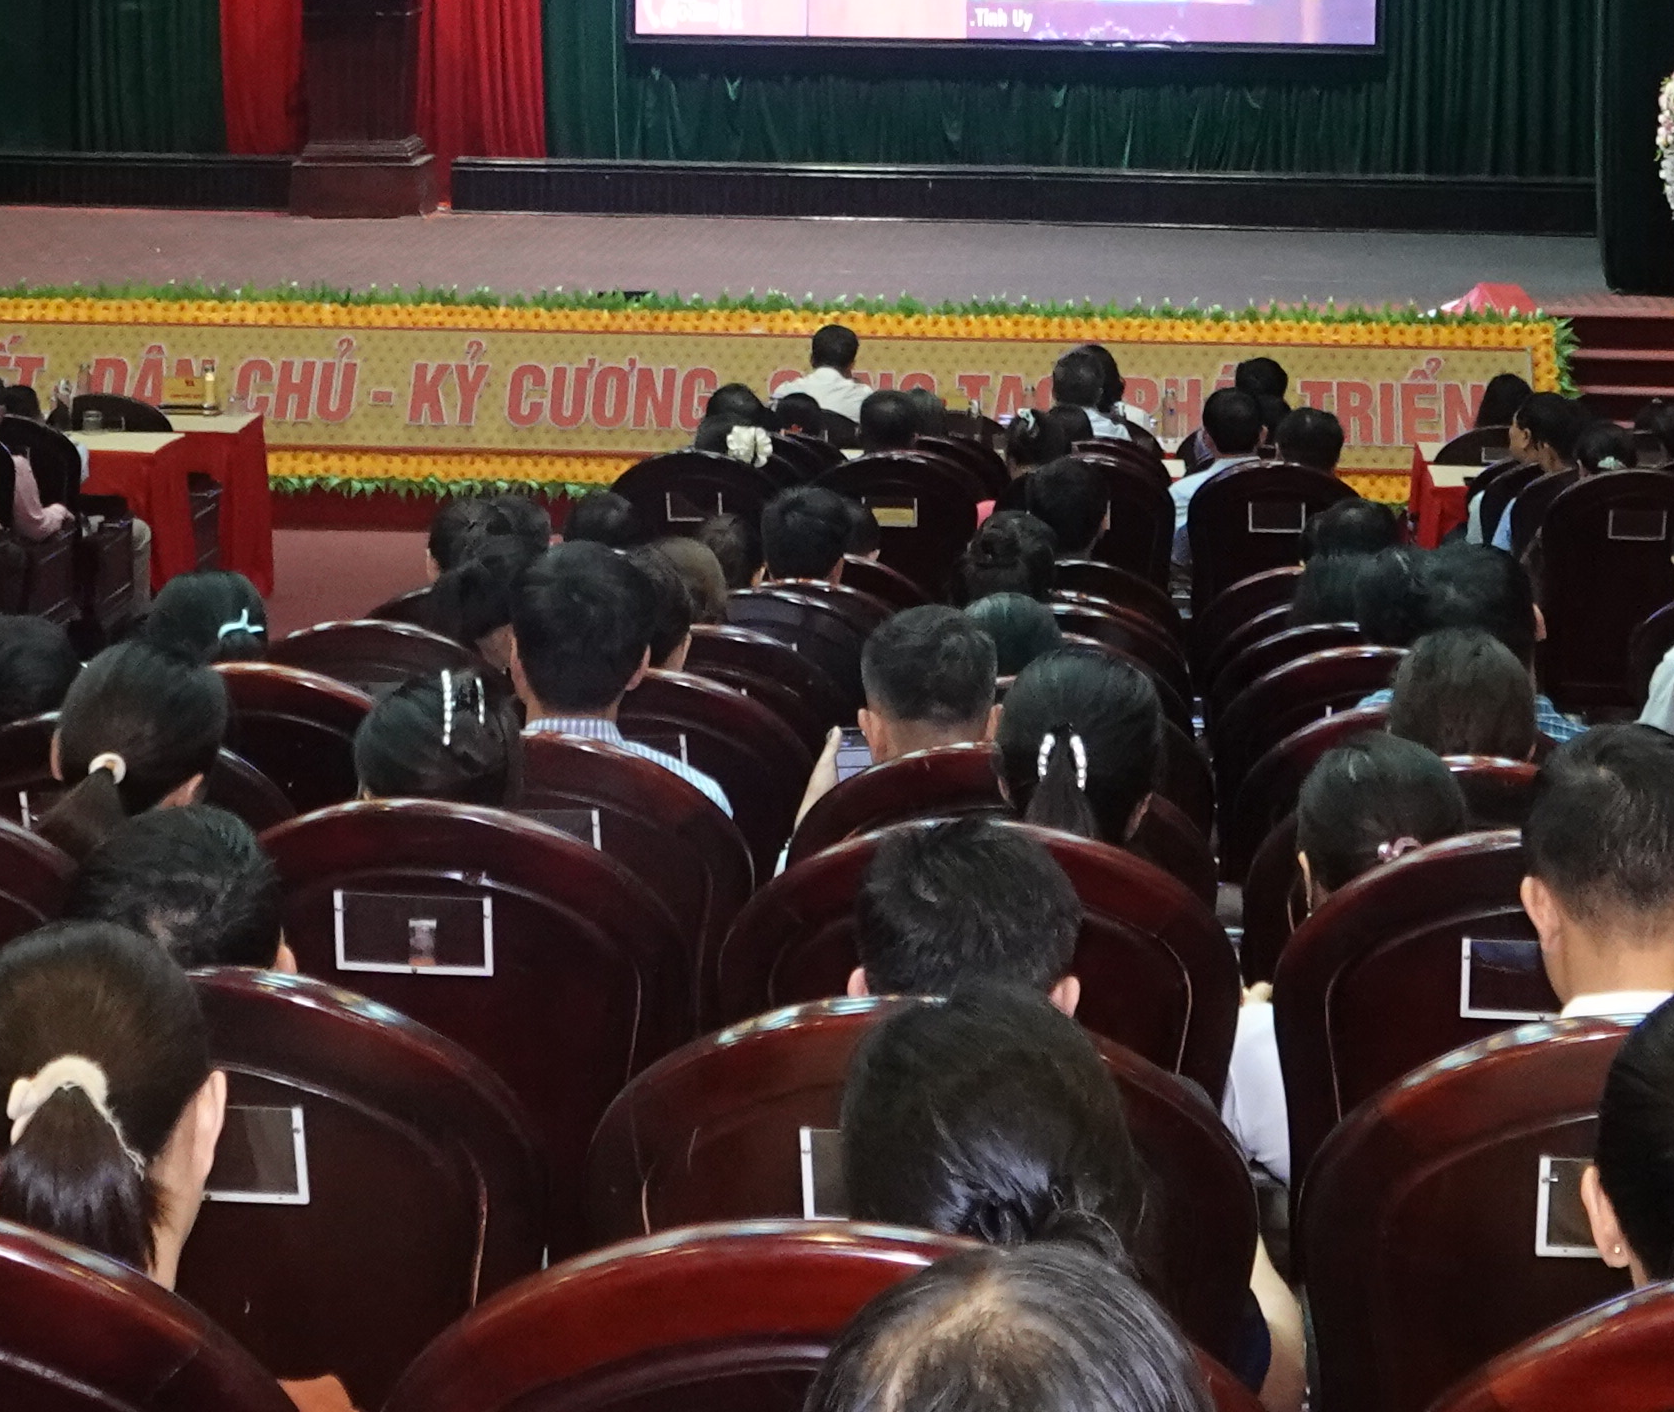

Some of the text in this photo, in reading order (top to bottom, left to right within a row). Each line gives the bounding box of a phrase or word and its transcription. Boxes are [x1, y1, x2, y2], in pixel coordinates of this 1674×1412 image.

[235, 336, 358, 422] CHỦ
[371, 390, 393, 405] -
[408, 339, 490, 426] KỶ
[506, 356, 718, 431] CƯƠNG
[1300, 357, 1486, 446] TRIỂN
